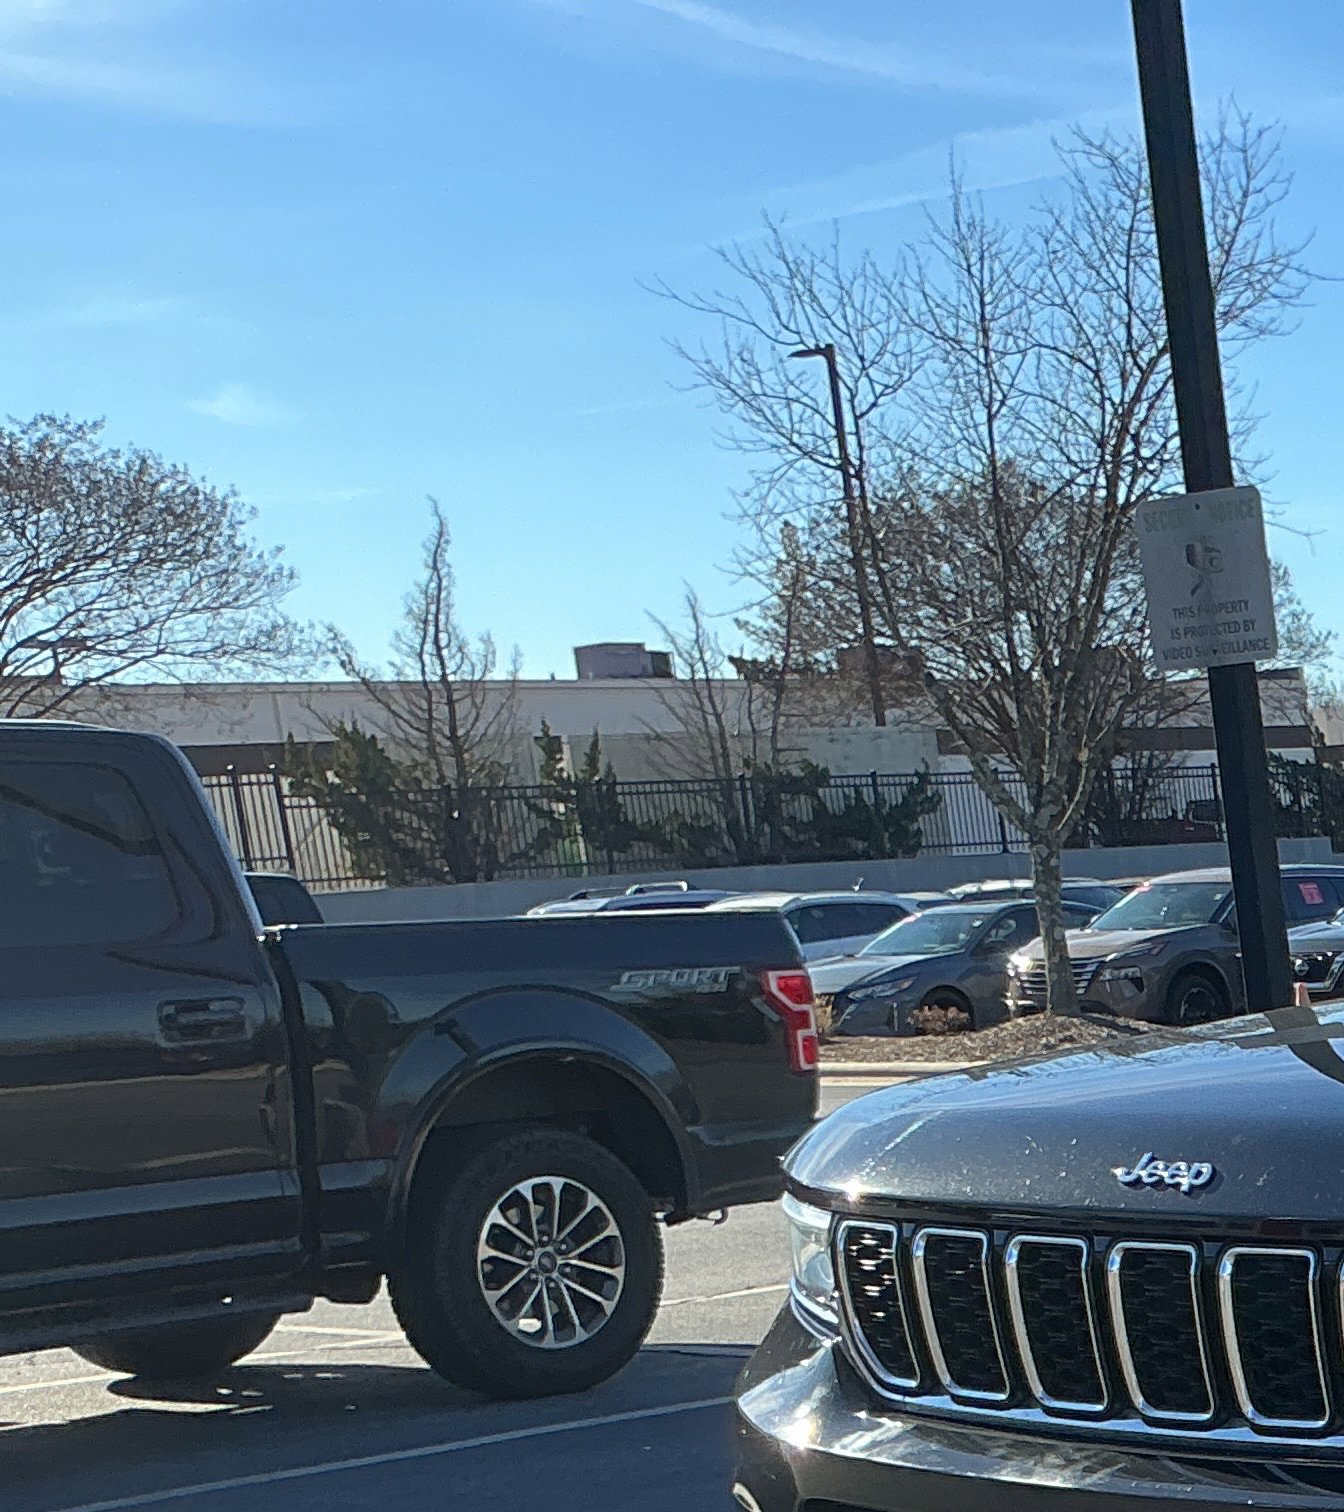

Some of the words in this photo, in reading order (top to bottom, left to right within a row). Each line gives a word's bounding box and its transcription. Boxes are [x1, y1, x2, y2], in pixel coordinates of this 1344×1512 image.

[1243, 618, 1257, 634] BY
[1161, 646, 1194, 661] VIDEO
[609, 966, 742, 993] SPORT
[1110, 1151, 1214, 1192] Jeep
